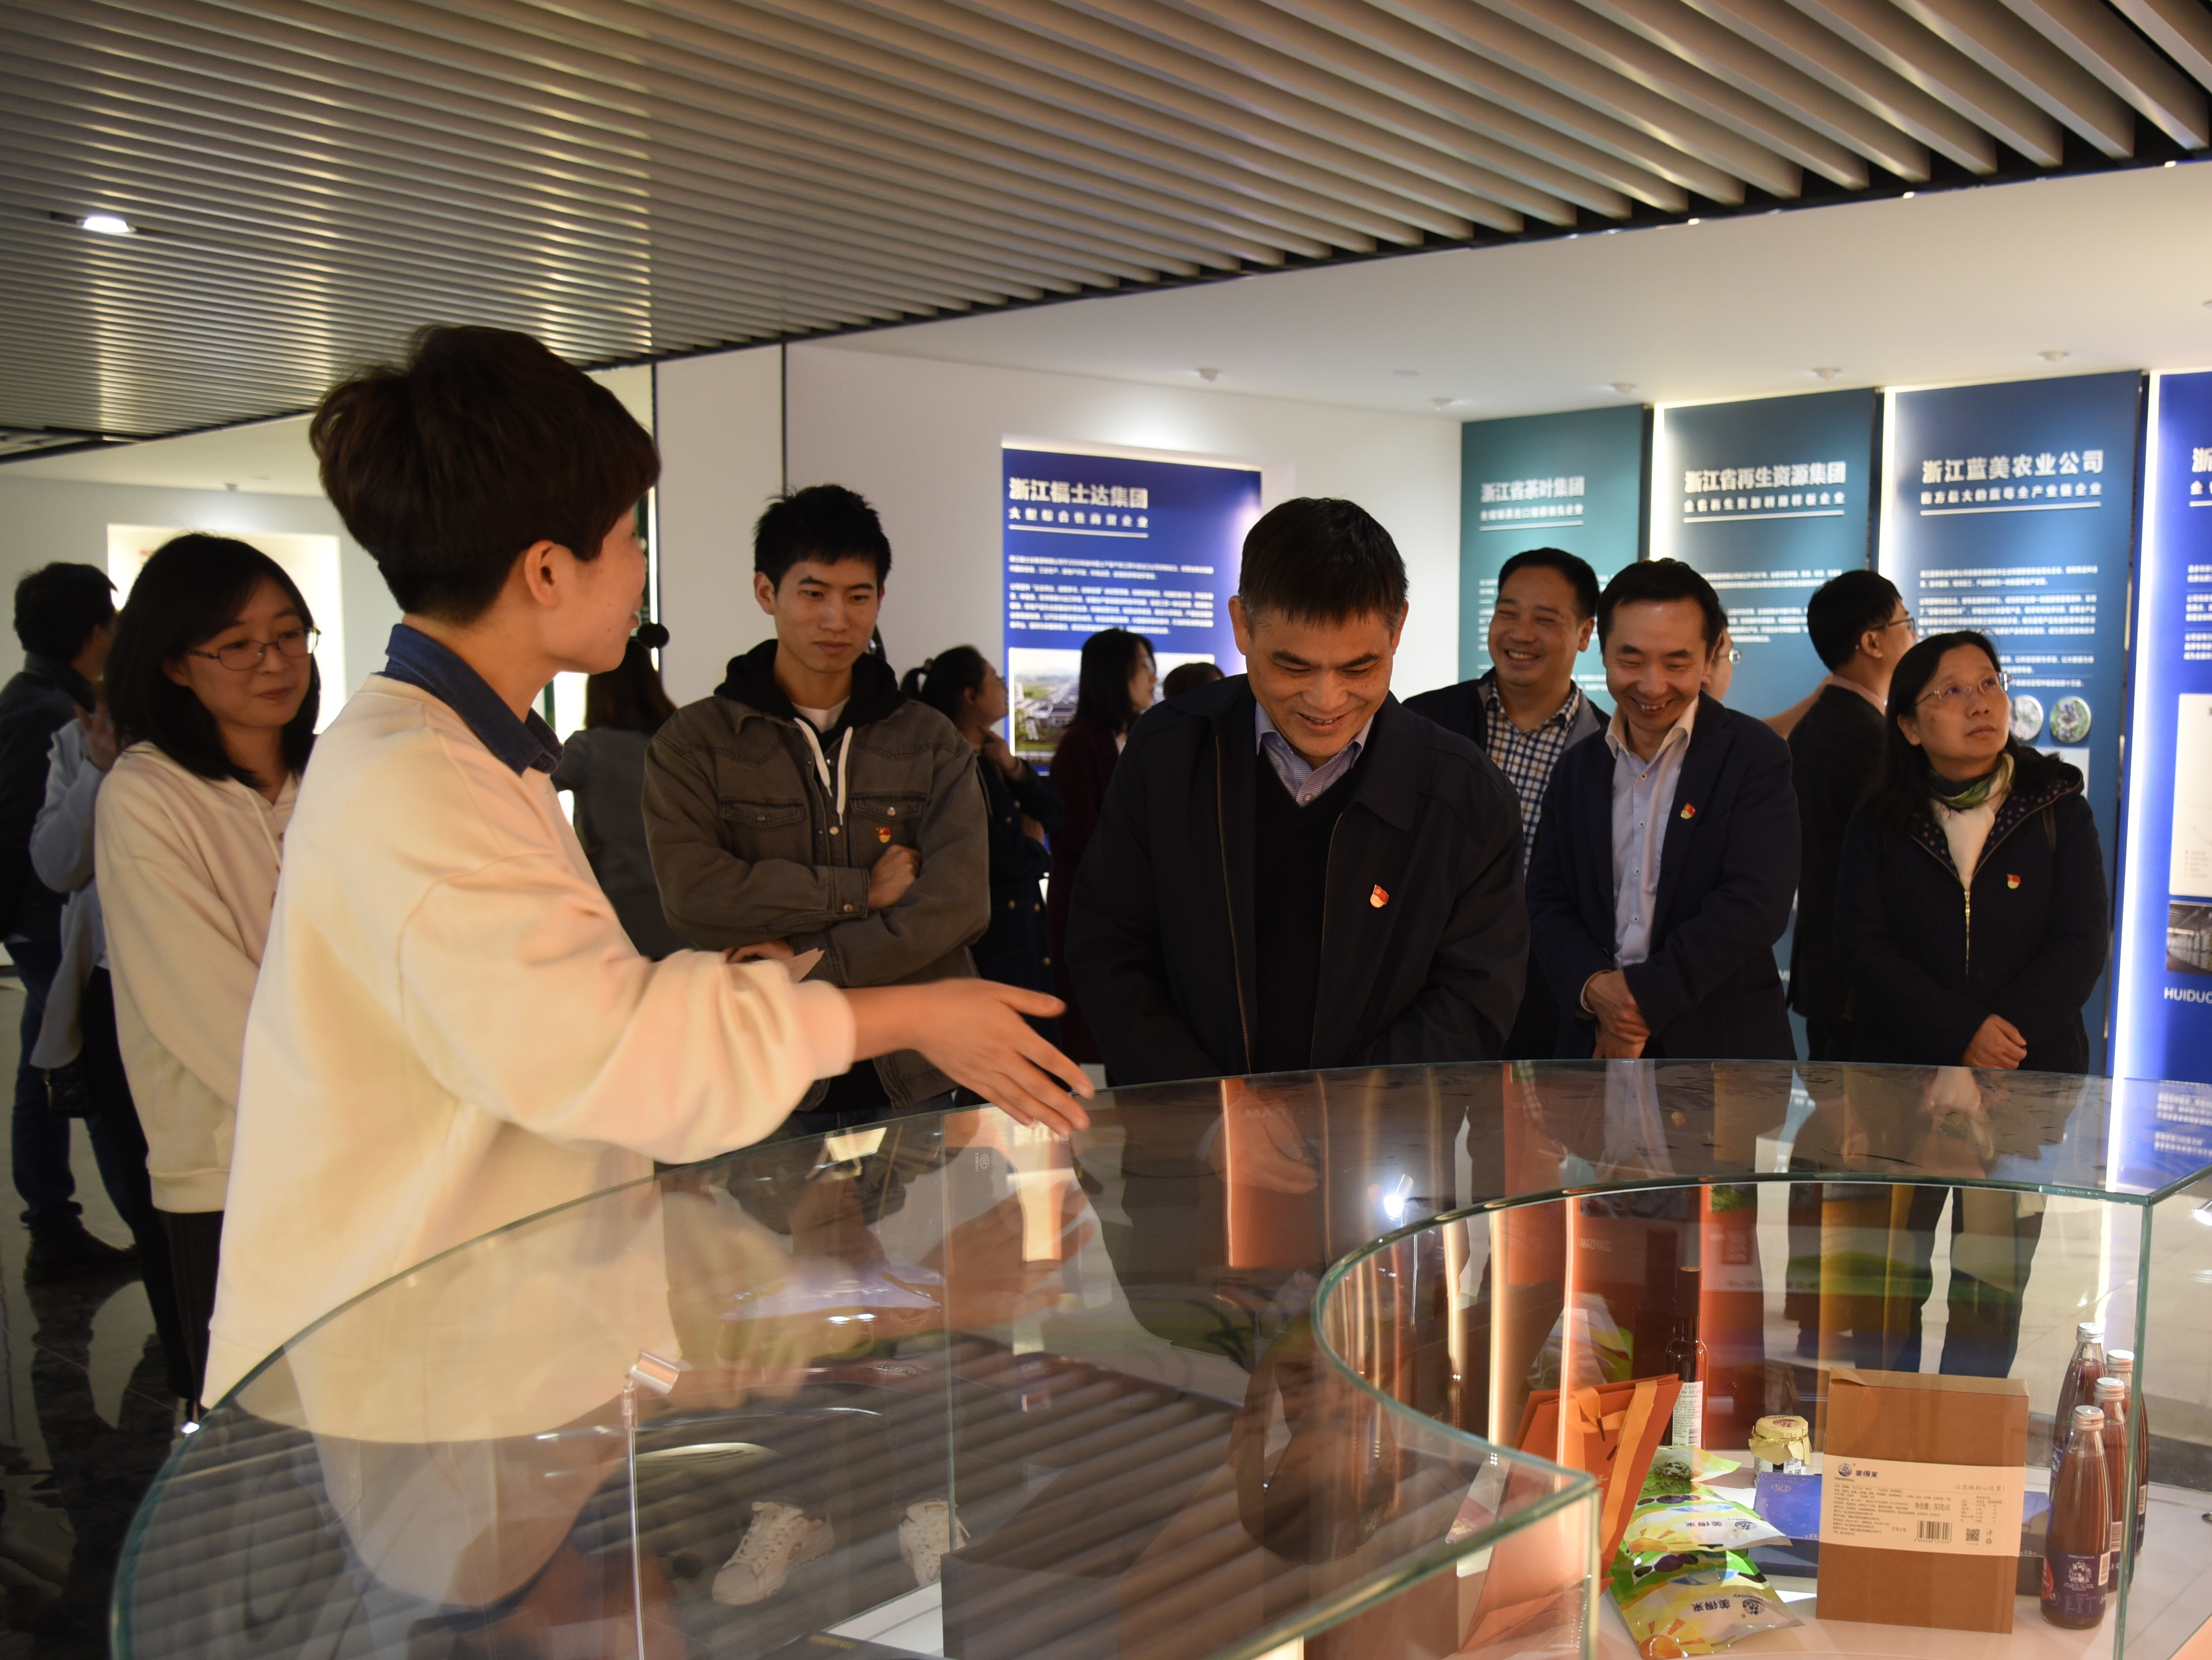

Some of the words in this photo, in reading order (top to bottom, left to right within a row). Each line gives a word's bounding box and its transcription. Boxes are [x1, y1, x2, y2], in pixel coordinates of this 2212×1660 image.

[1684, 461, 1846, 493] 浙江省再生资源集团
[1922, 449, 2104, 484] 浙江蓝美农业公司
[1008, 477, 1148, 509] 浙江福士达集团
[1480, 475, 1585, 503] 浙江省茶叶集团
[1920, 482, 2102, 505] 南方最大的蓝莓全产业链企业
[2190, 480, 2212, 495] 全
[1008, 507, 1149, 528] 大型综合性商贸企业
[1855, 1470, 1879, 1479] 美得来
[1691, 1598, 1731, 1613] 美得来
